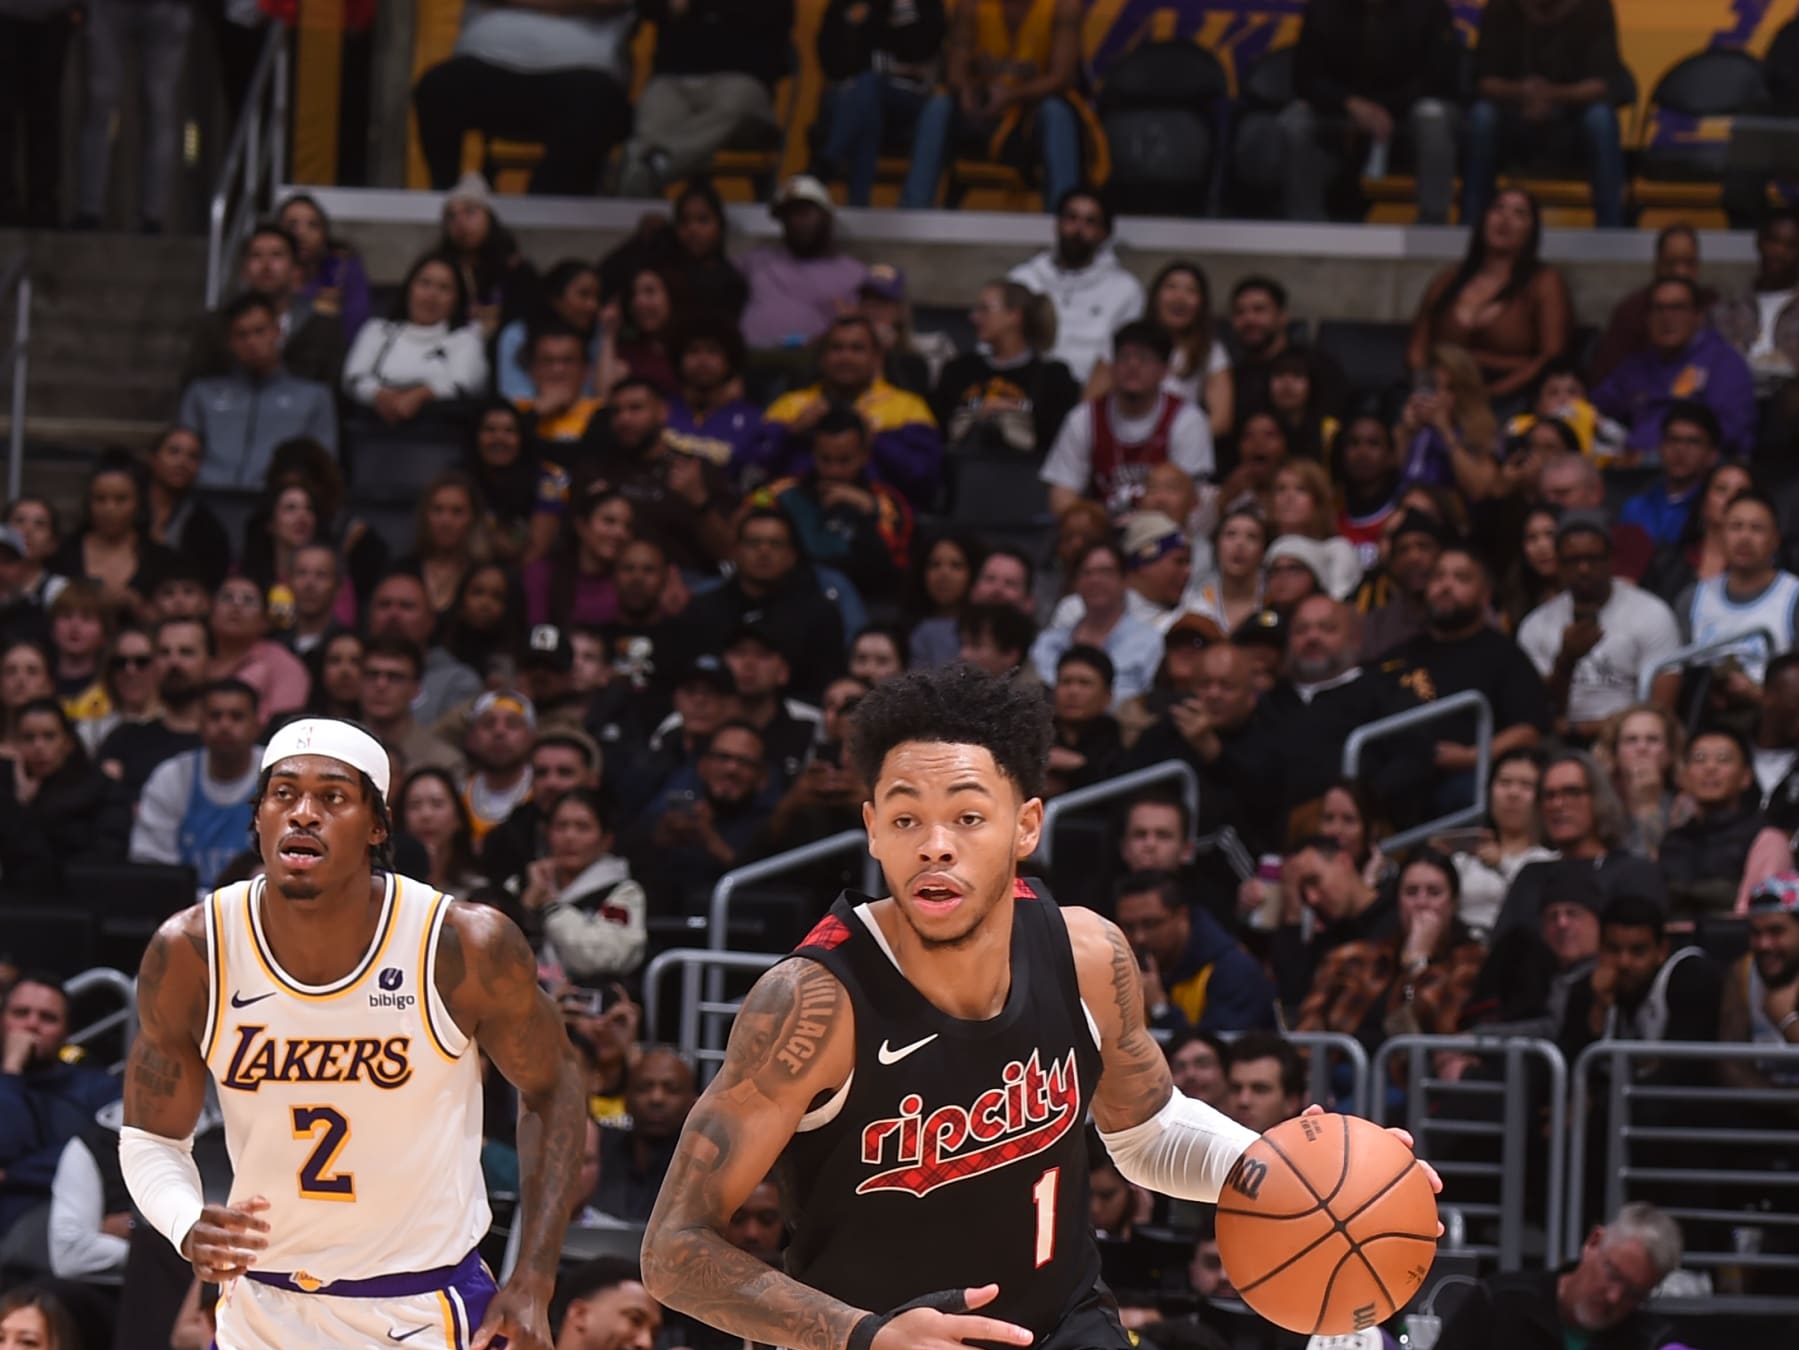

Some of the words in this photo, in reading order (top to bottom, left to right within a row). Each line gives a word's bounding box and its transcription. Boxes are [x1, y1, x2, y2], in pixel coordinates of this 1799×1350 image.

[369, 993, 415, 1010] bibigo
[220, 1024, 415, 1093] LAKERS
[289, 1104, 357, 1203] 2
[1032, 1166, 1062, 1269] 1
